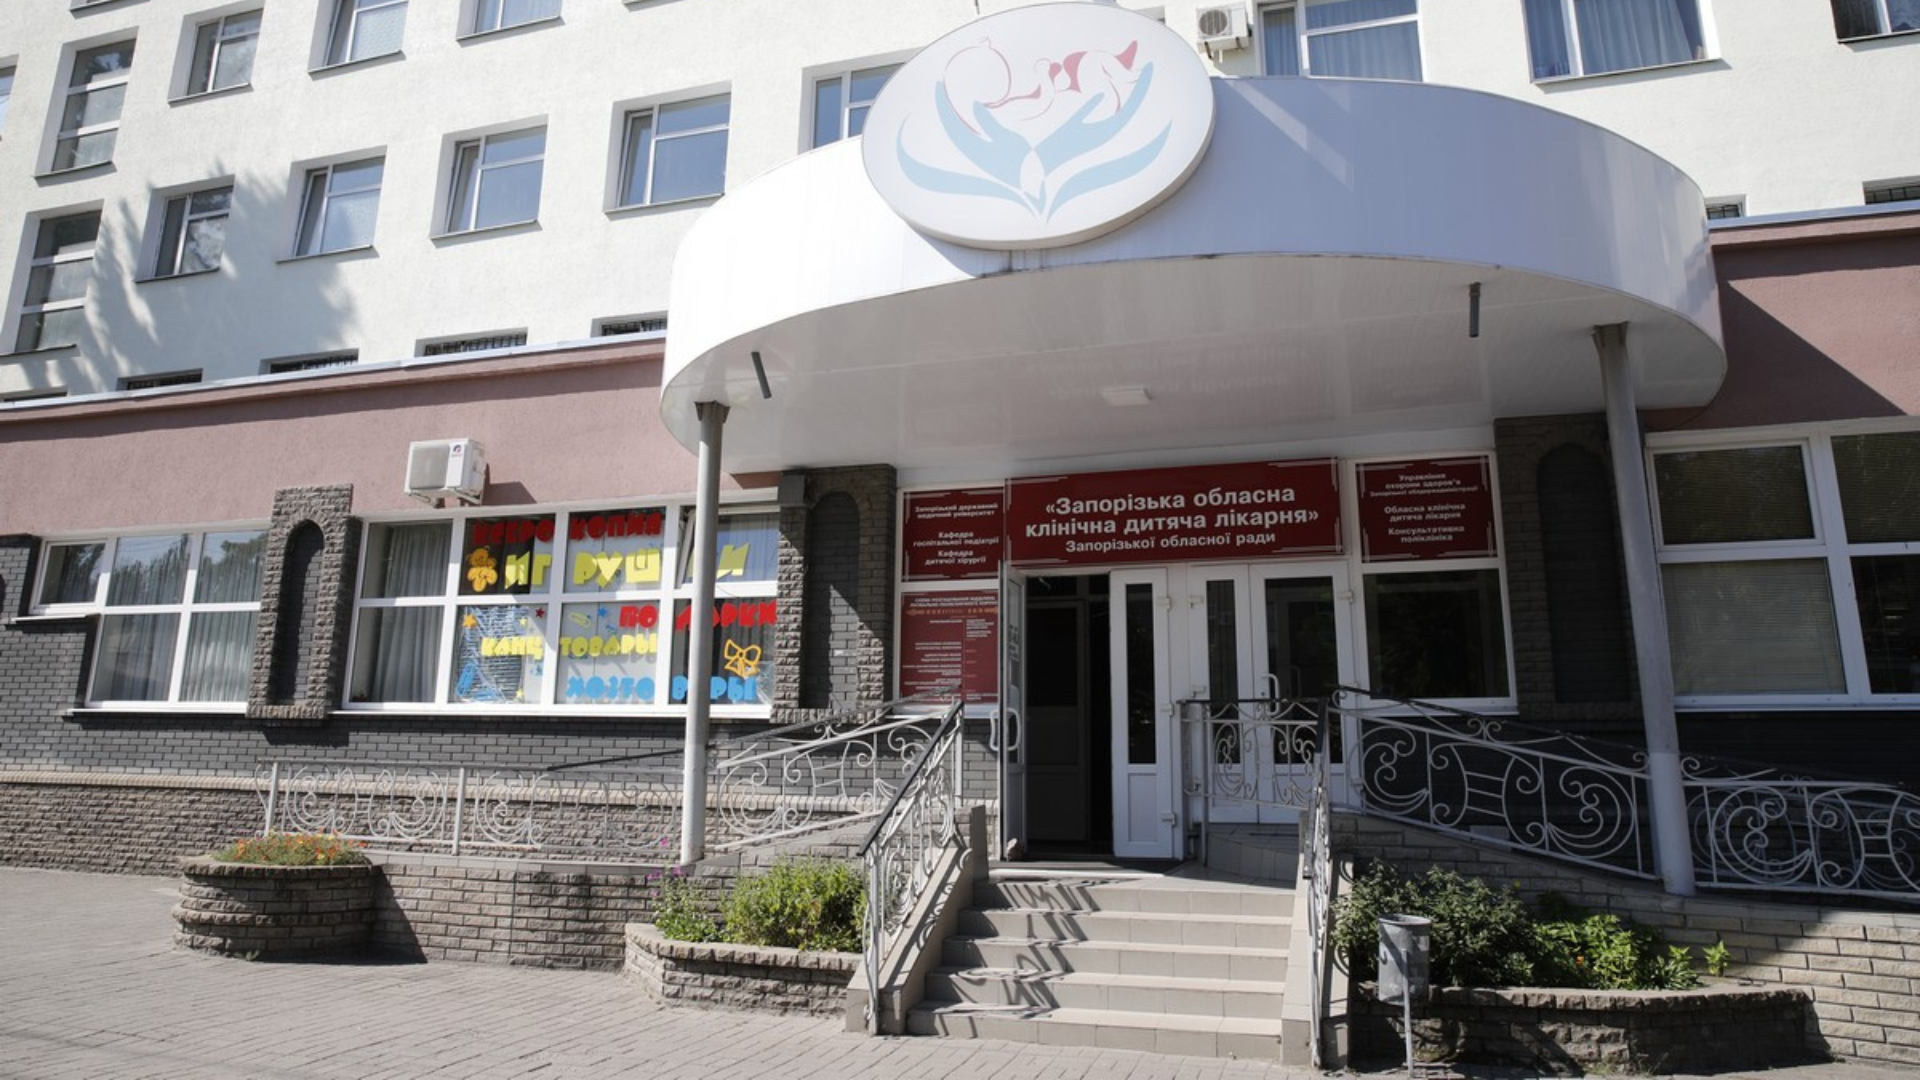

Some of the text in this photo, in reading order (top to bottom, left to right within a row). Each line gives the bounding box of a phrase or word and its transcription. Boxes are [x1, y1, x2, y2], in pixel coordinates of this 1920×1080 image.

[1398, 473, 1446, 482] Управління
[1385, 482, 1420, 490] охорони
[1046, 487, 1295, 516] «Запорізька обласна
[1384, 503, 1466, 515] Обласна клінічна
[1026, 507, 1318, 537] клінічна дитяча лікарня»
[1389, 511, 1462, 523] дитяча лікарня
[938, 531, 974, 540] Кафедра
[1388, 526, 1465, 536] Консультативна
[963, 536, 999, 546] педіатрії
[1065, 531, 1275, 554] Запорізької обласної ради
[1401, 534, 1454, 544] поліклініка
[937, 550, 974, 559] Кафедра
[924, 555, 987, 566] дитячої хірургії
